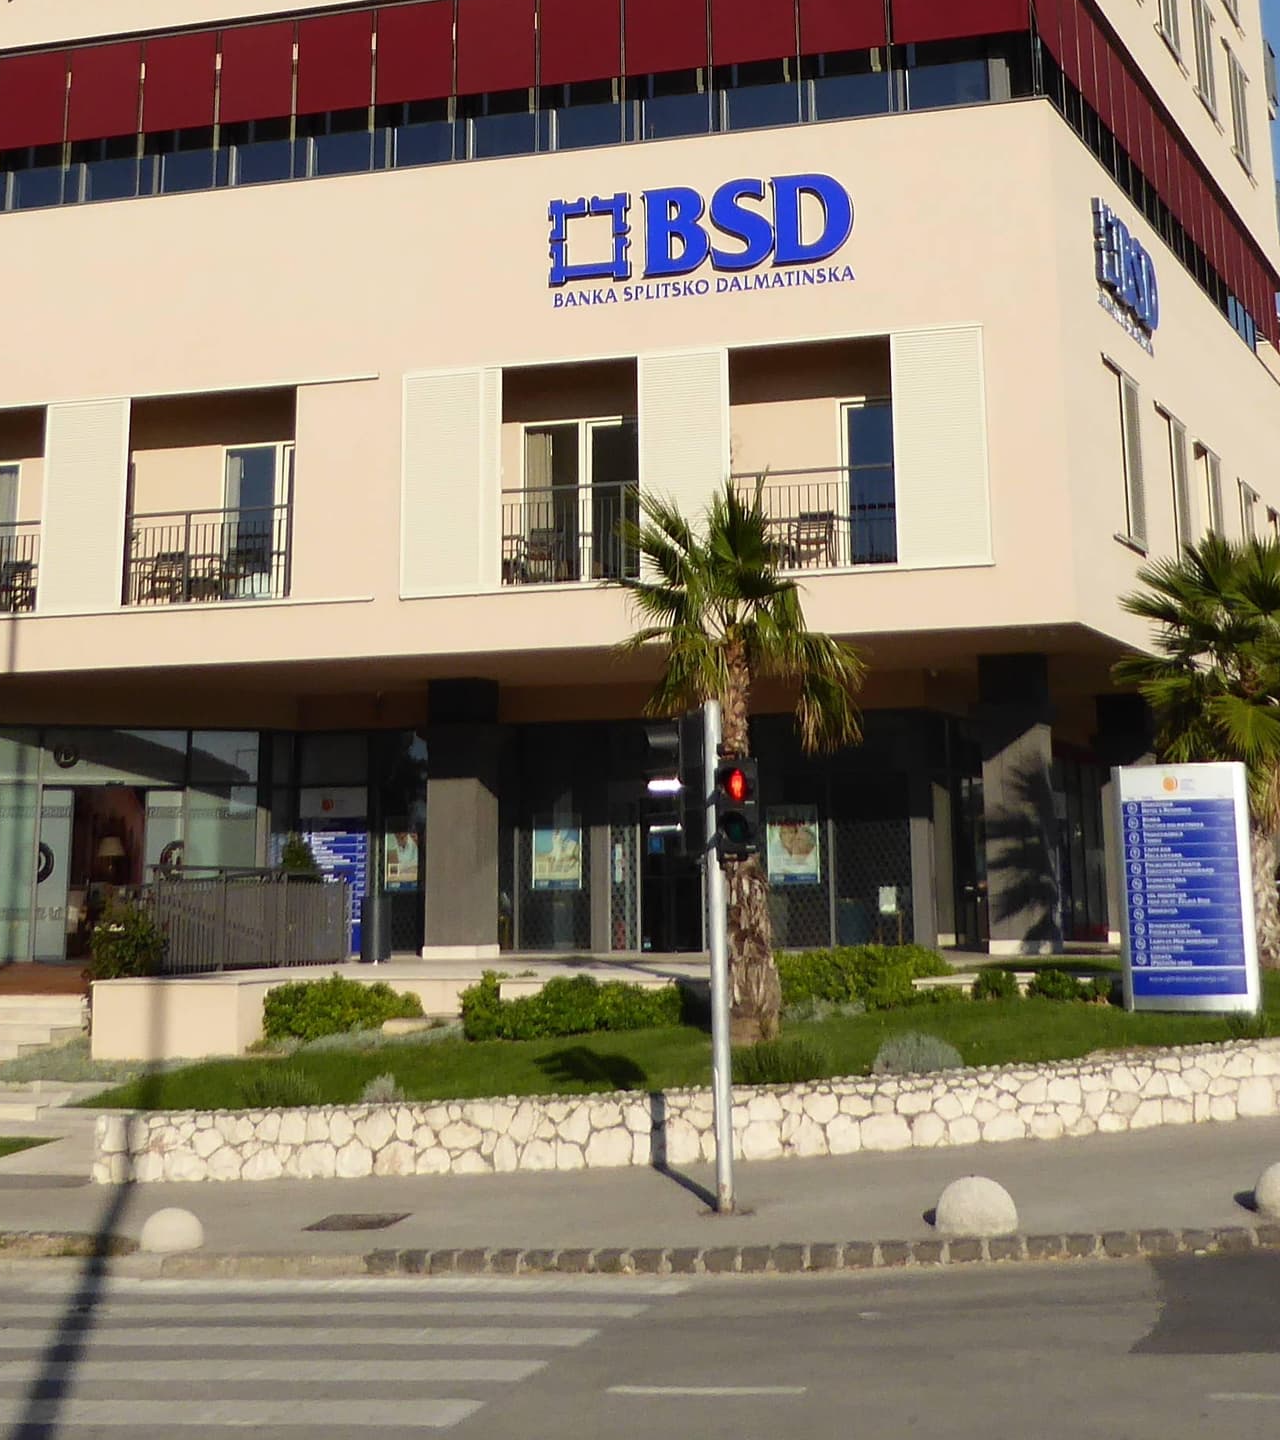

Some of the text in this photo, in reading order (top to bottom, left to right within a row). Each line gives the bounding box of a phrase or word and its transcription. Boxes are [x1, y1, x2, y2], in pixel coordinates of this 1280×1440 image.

[641, 173, 854, 279] BSD
[553, 265, 855, 308] BANKA SPLITSKO DALMATINSKA
